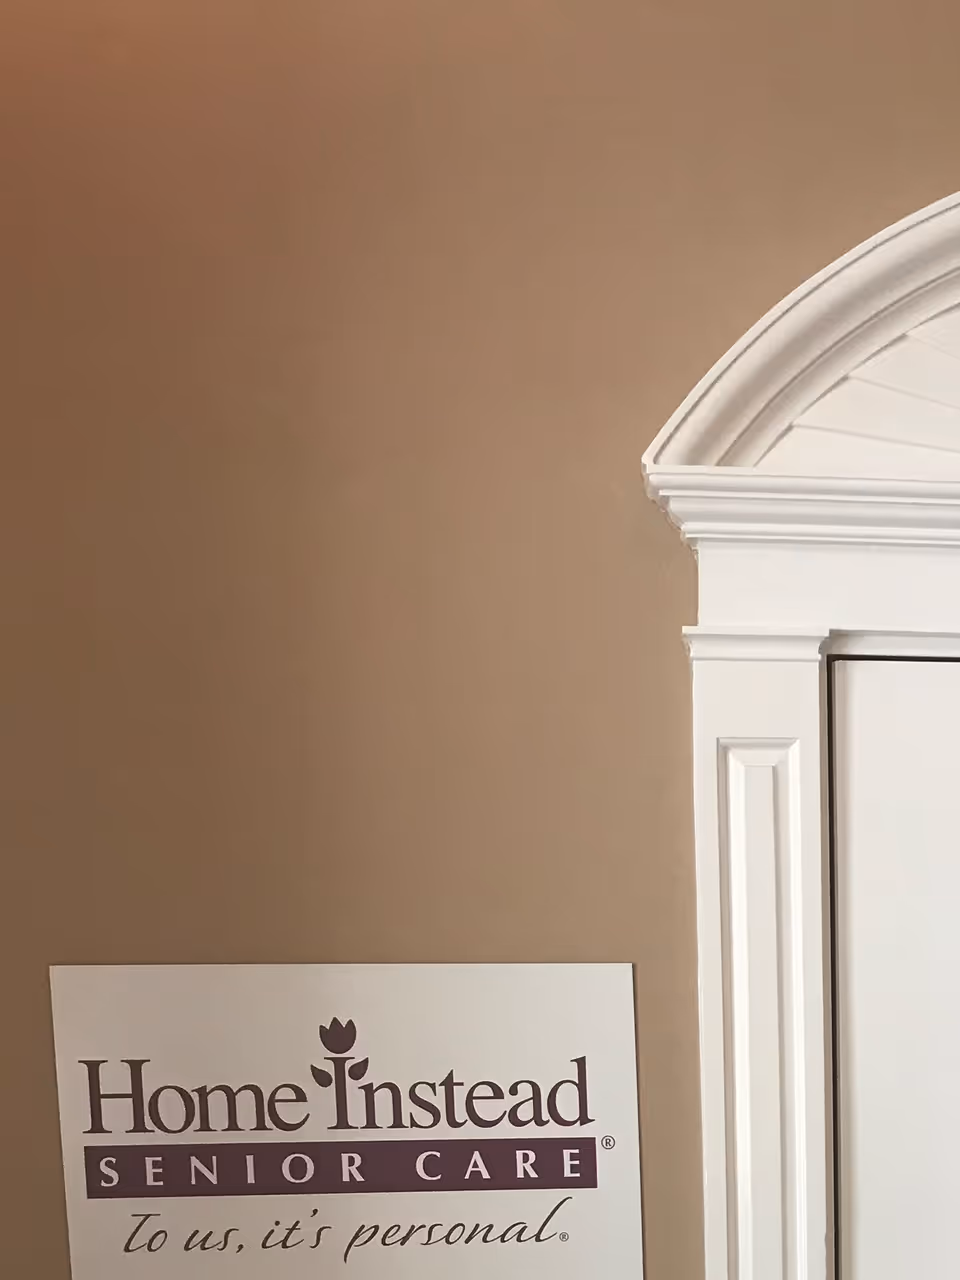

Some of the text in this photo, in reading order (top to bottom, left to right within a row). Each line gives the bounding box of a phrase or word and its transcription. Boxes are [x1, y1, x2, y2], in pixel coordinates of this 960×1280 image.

[77, 1055, 596, 1135] Home Instead
[99, 1152, 366, 1188] SENIOR
[415, 1149, 582, 1182] CARE
[123, 1213, 168, 1253] To
[184, 1229, 244, 1254] us,
[261, 1208, 332, 1250] it's
